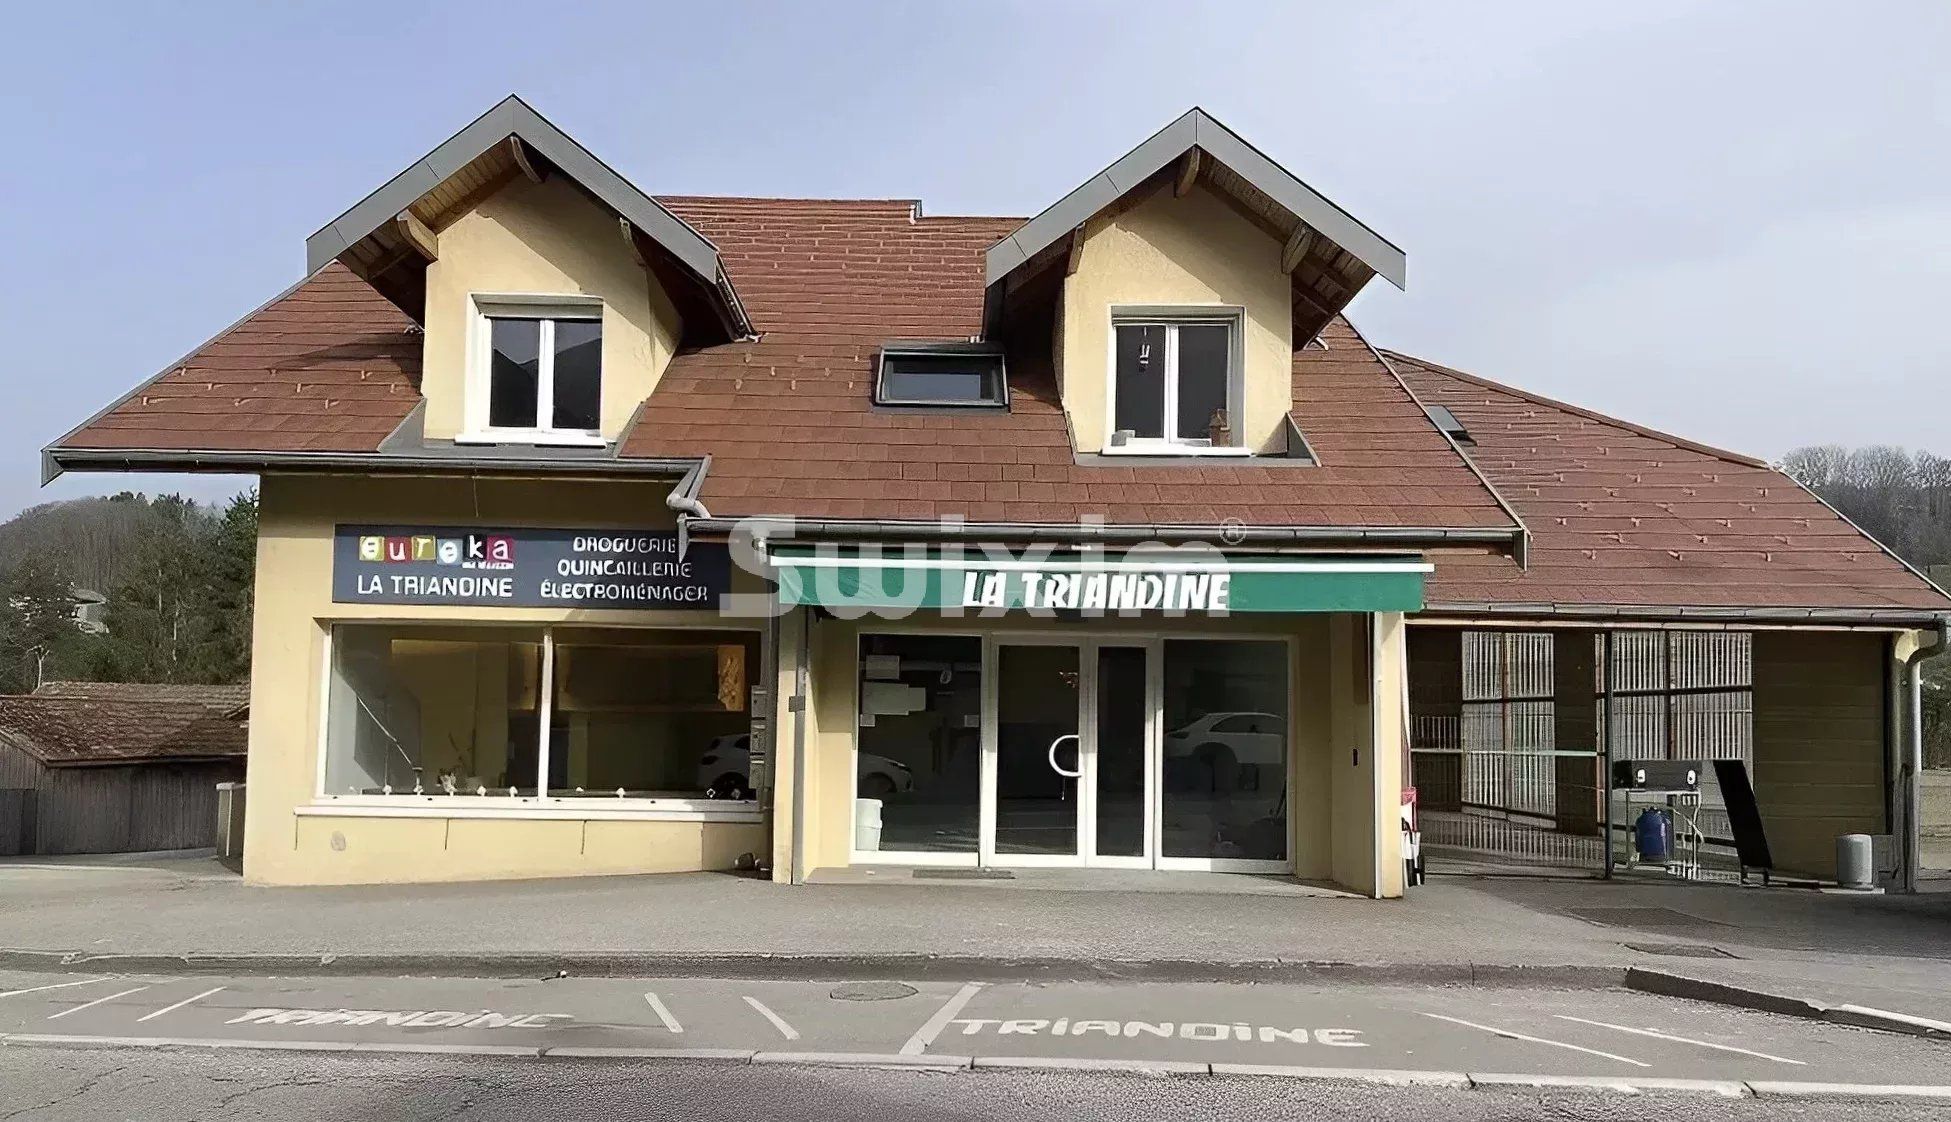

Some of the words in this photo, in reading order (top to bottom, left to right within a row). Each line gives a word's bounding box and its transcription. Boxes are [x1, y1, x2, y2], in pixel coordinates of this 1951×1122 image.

[360, 534, 510, 565] eureka
[572, 536, 677, 554] DROGUERIE
[556, 558, 692, 578] QUINCAILLERIE
[357, 574, 384, 595] LA
[390, 574, 514, 598] TRIANDINE
[962, 570, 1008, 608] LA
[1020, 572, 1232, 610] TRIANDINE
